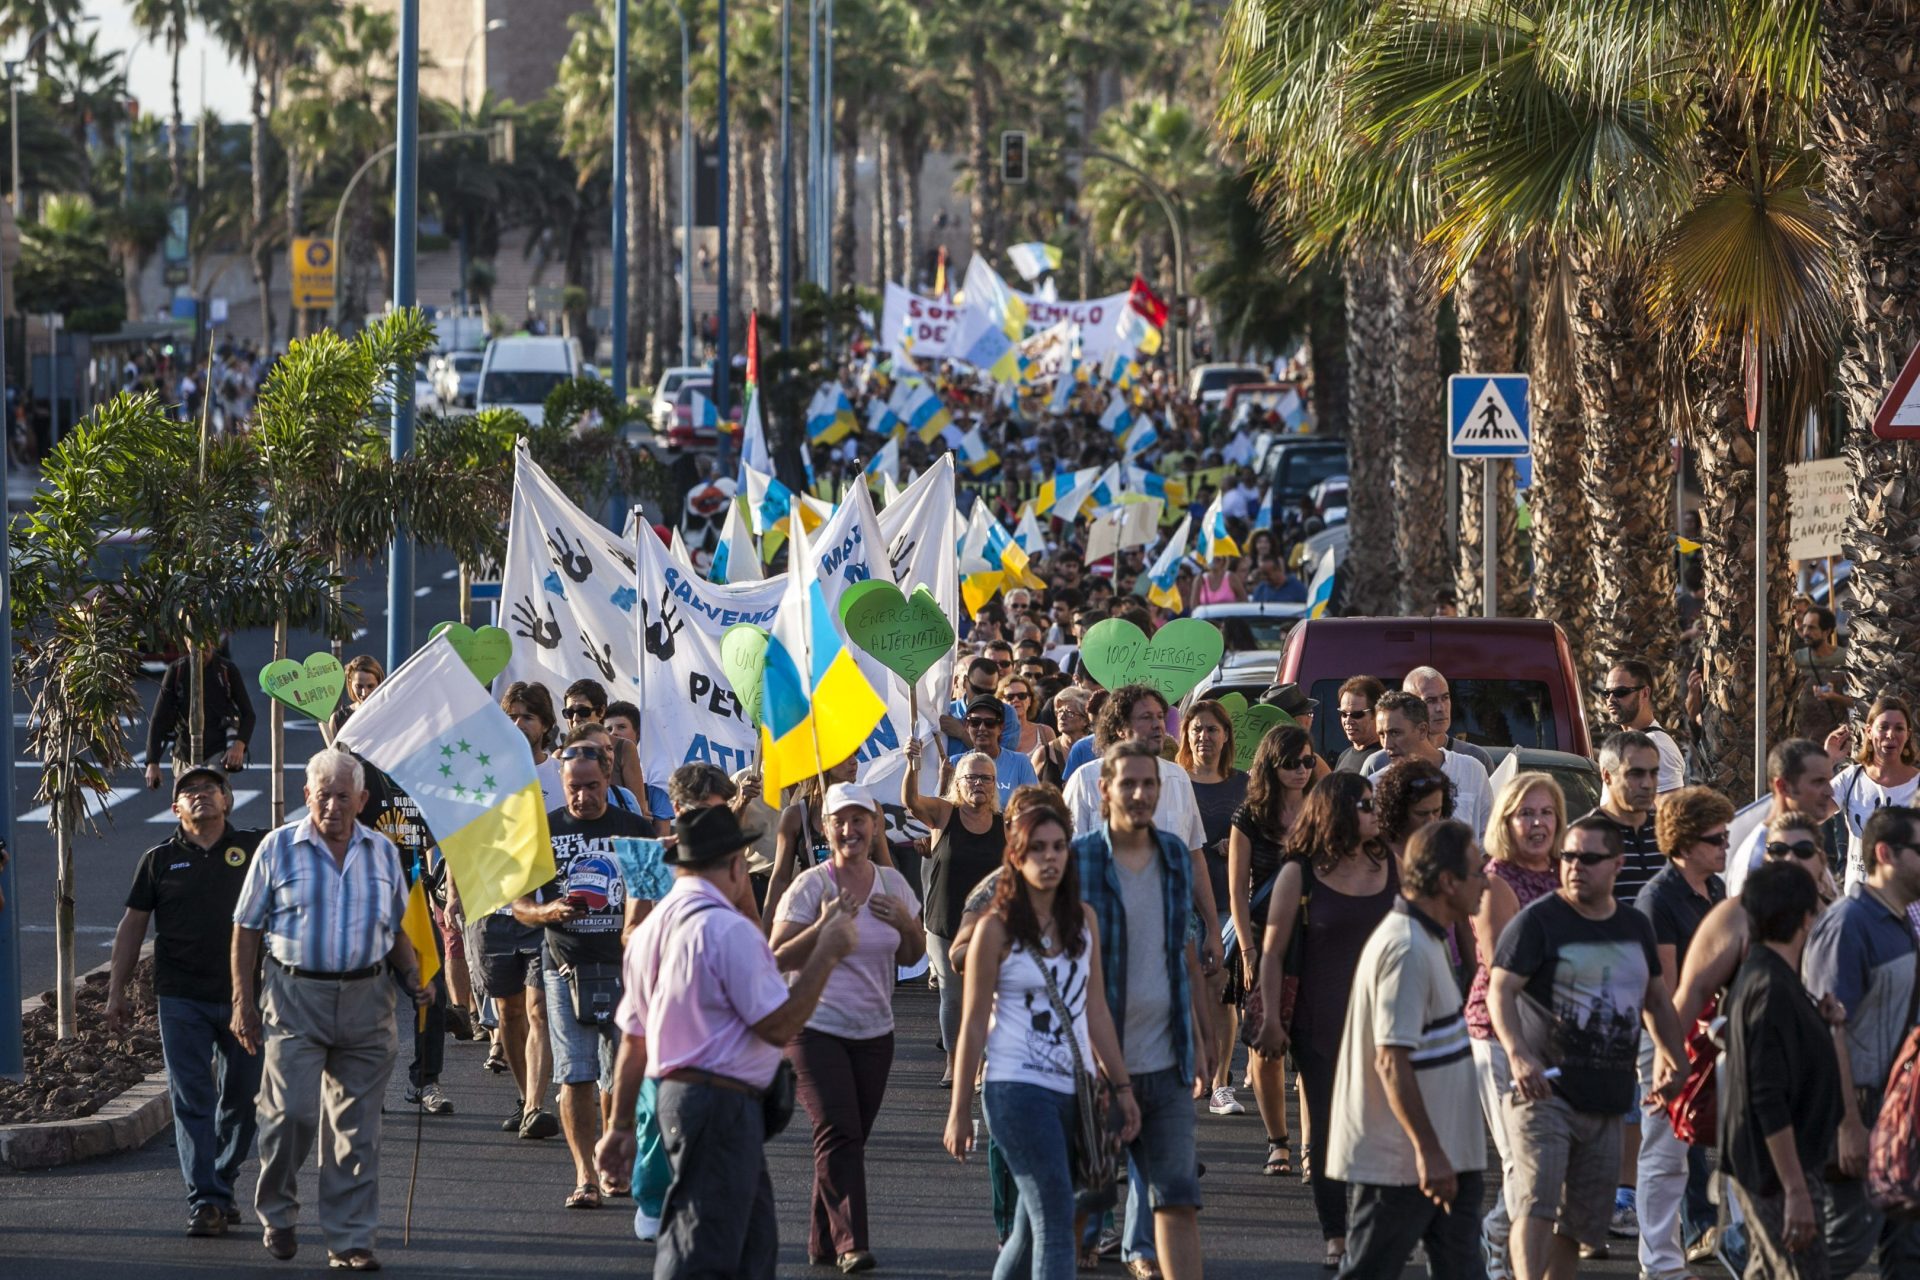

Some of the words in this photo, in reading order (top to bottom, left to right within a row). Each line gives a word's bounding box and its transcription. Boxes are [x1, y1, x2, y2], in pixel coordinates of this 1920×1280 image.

[1026, 302, 1103, 324] EMIGO
[918, 323, 947, 342] DE
[1106, 641, 1142, 675] 100%
[1143, 646, 1208, 667] ENERGÍAS
[550, 833, 584, 847] STYLE
[571, 918, 613, 926] AMERICAN
